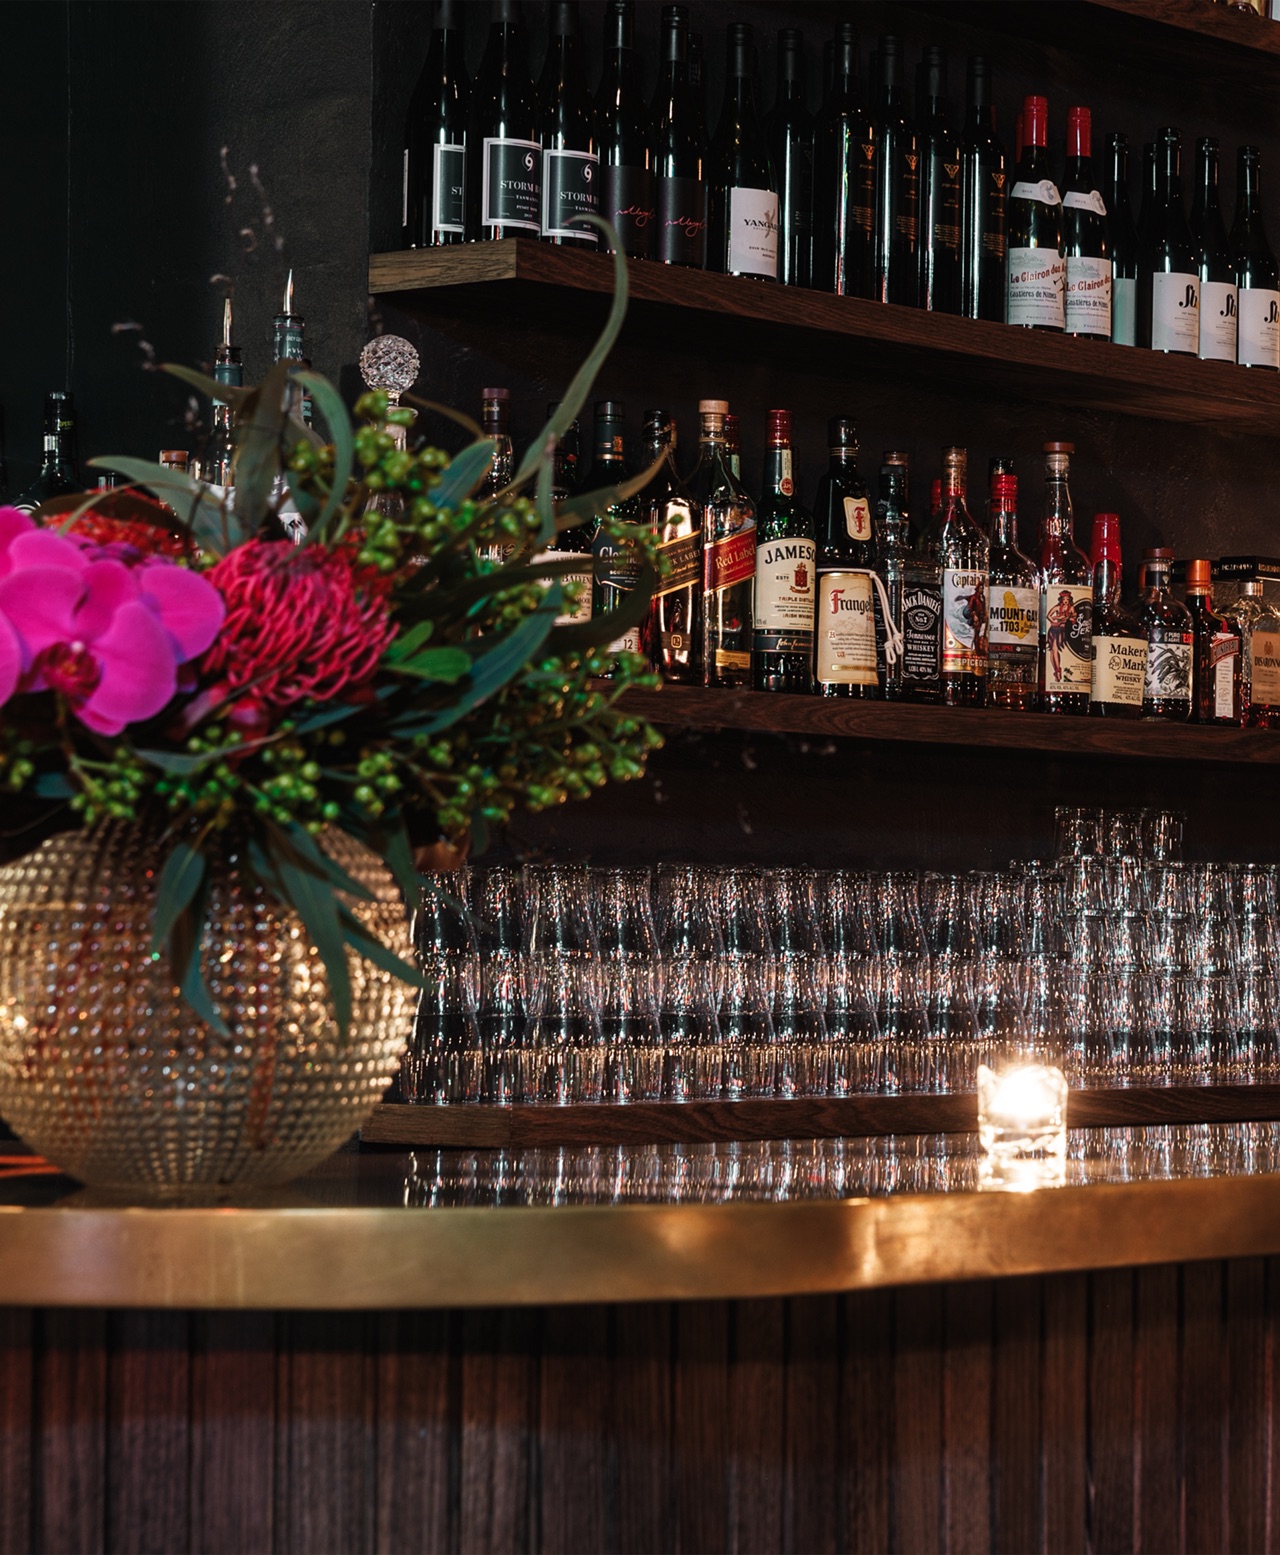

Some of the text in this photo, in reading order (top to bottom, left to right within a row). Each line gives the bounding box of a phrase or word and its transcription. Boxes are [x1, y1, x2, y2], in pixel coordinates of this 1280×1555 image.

[500, 180, 534, 192] STORM
[560, 191, 592, 203] STORM
[1010, 273, 1020, 284] Le
[1021, 270, 1050, 283] Clairon
[1066, 281, 1076, 292] Le
[1078, 278, 1104, 291] Clairon
[1035, 290, 1042, 298] de
[715, 544, 756, 570] Red Label
[902, 595, 917, 612] JACK
[990, 607, 1025, 621] MOUNT
[999, 621, 1020, 632] 1703
[623, 638, 633, 650] 12
[907, 644, 935, 652] WHISKEY
[1109, 643, 1147, 658] Maker's
[1122, 659, 1146, 671] Mark
[1115, 675, 1141, 683] WHISKY
